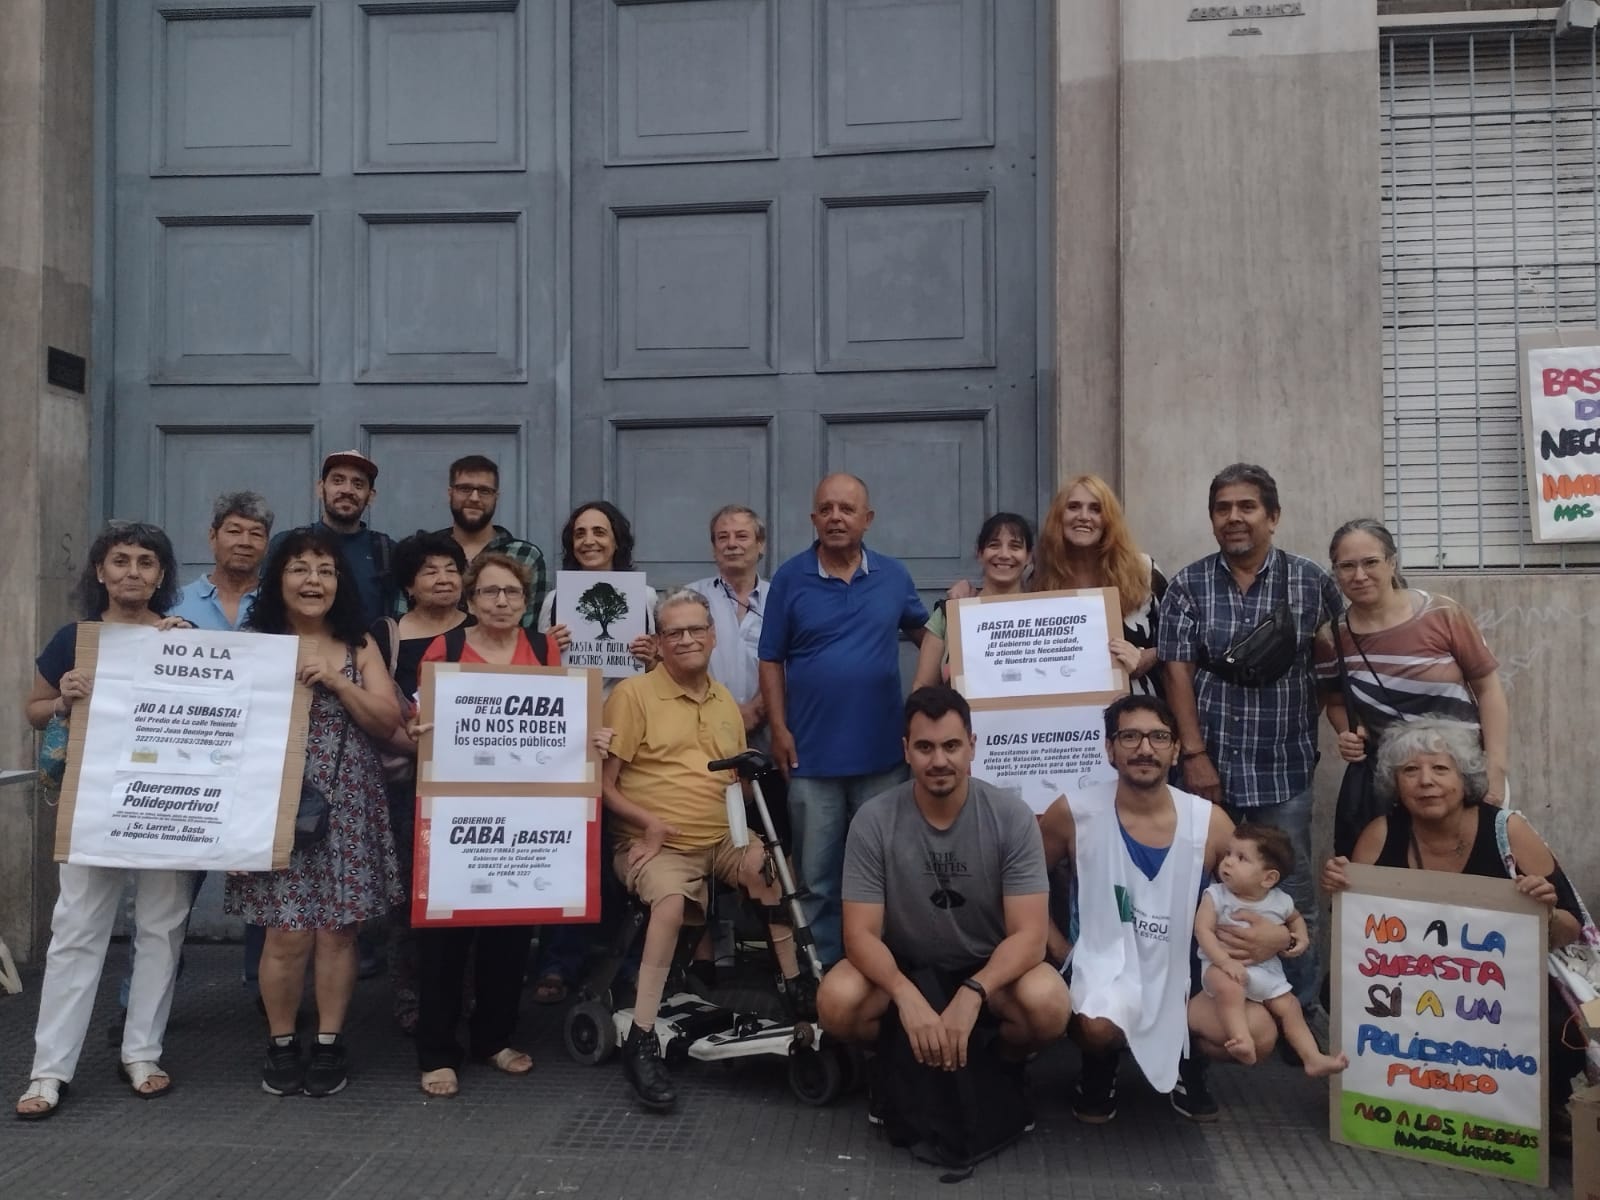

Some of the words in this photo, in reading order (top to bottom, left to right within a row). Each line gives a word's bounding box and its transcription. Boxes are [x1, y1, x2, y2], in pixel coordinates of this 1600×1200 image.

[1542, 368, 1600, 396] BAS
[1575, 399, 1600, 420] D
[977, 620, 1014, 632] ¡BASTA
[1018, 619, 1032, 628] DE
[1035, 614, 1087, 626] NEGOCIOS
[990, 626, 1074, 640] INMOBILIARIOS!
[162, 644, 187, 656] NO
[192, 646, 204, 658] A
[210, 648, 231, 660] LA
[596, 642, 602, 652] DE
[606, 642, 631, 652] MUTILA
[996, 648, 1023, 656] atiende
[1038, 646, 1083, 654] Necesidades
[999, 640, 1030, 648] Gobierno
[569, 655, 603, 665] NUESTROS
[154, 664, 234, 680] SUBASTA
[455, 696, 501, 705] GOBIERNO
[504, 695, 564, 717] CABA
[134, 703, 156, 714] ¡NO
[157, 704, 166, 714] A
[169, 705, 184, 715] LA
[186, 706, 242, 718] SUBASTA!
[475, 705, 487, 714] DE
[490, 706, 501, 714] LA
[455, 718, 480, 734] ¡NO
[486, 719, 514, 733] NOS
[519, 720, 566, 734] ROBEN
[454, 735, 470, 745] los
[473, 735, 517, 747] espacios
[520, 735, 566, 748] públicos!
[986, 733, 1028, 746] LOS/AS
[1032, 730, 1100, 744] VECINOS/AS
[125, 780, 200, 796] ¡Queremos
[204, 787, 221, 798] un
[122, 795, 219, 813] Polideportivo!
[133, 822, 143, 830] Sr.
[146, 822, 175, 832] Larreta
[182, 826, 205, 834] Basta
[452, 817, 492, 825] GOBIERNO
[110, 829, 121, 837] de
[122, 830, 159, 840] negocios
[160, 833, 213, 844] Inmobiliarios
[450, 826, 505, 845] CABA
[511, 830, 572, 847] ¡BASTA!
[1365, 914, 1407, 944] NO
[1423, 920, 1448, 947] A
[1460, 923, 1506, 958] LA
[1359, 948, 1505, 991] SUBASTA
[1416, 990, 1444, 1017] A
[1456, 995, 1502, 1024] UN
[1354, 1102, 1392, 1123] NO
[1396, 1110, 1410, 1126] A
[1414, 1114, 1456, 1135] LOS
